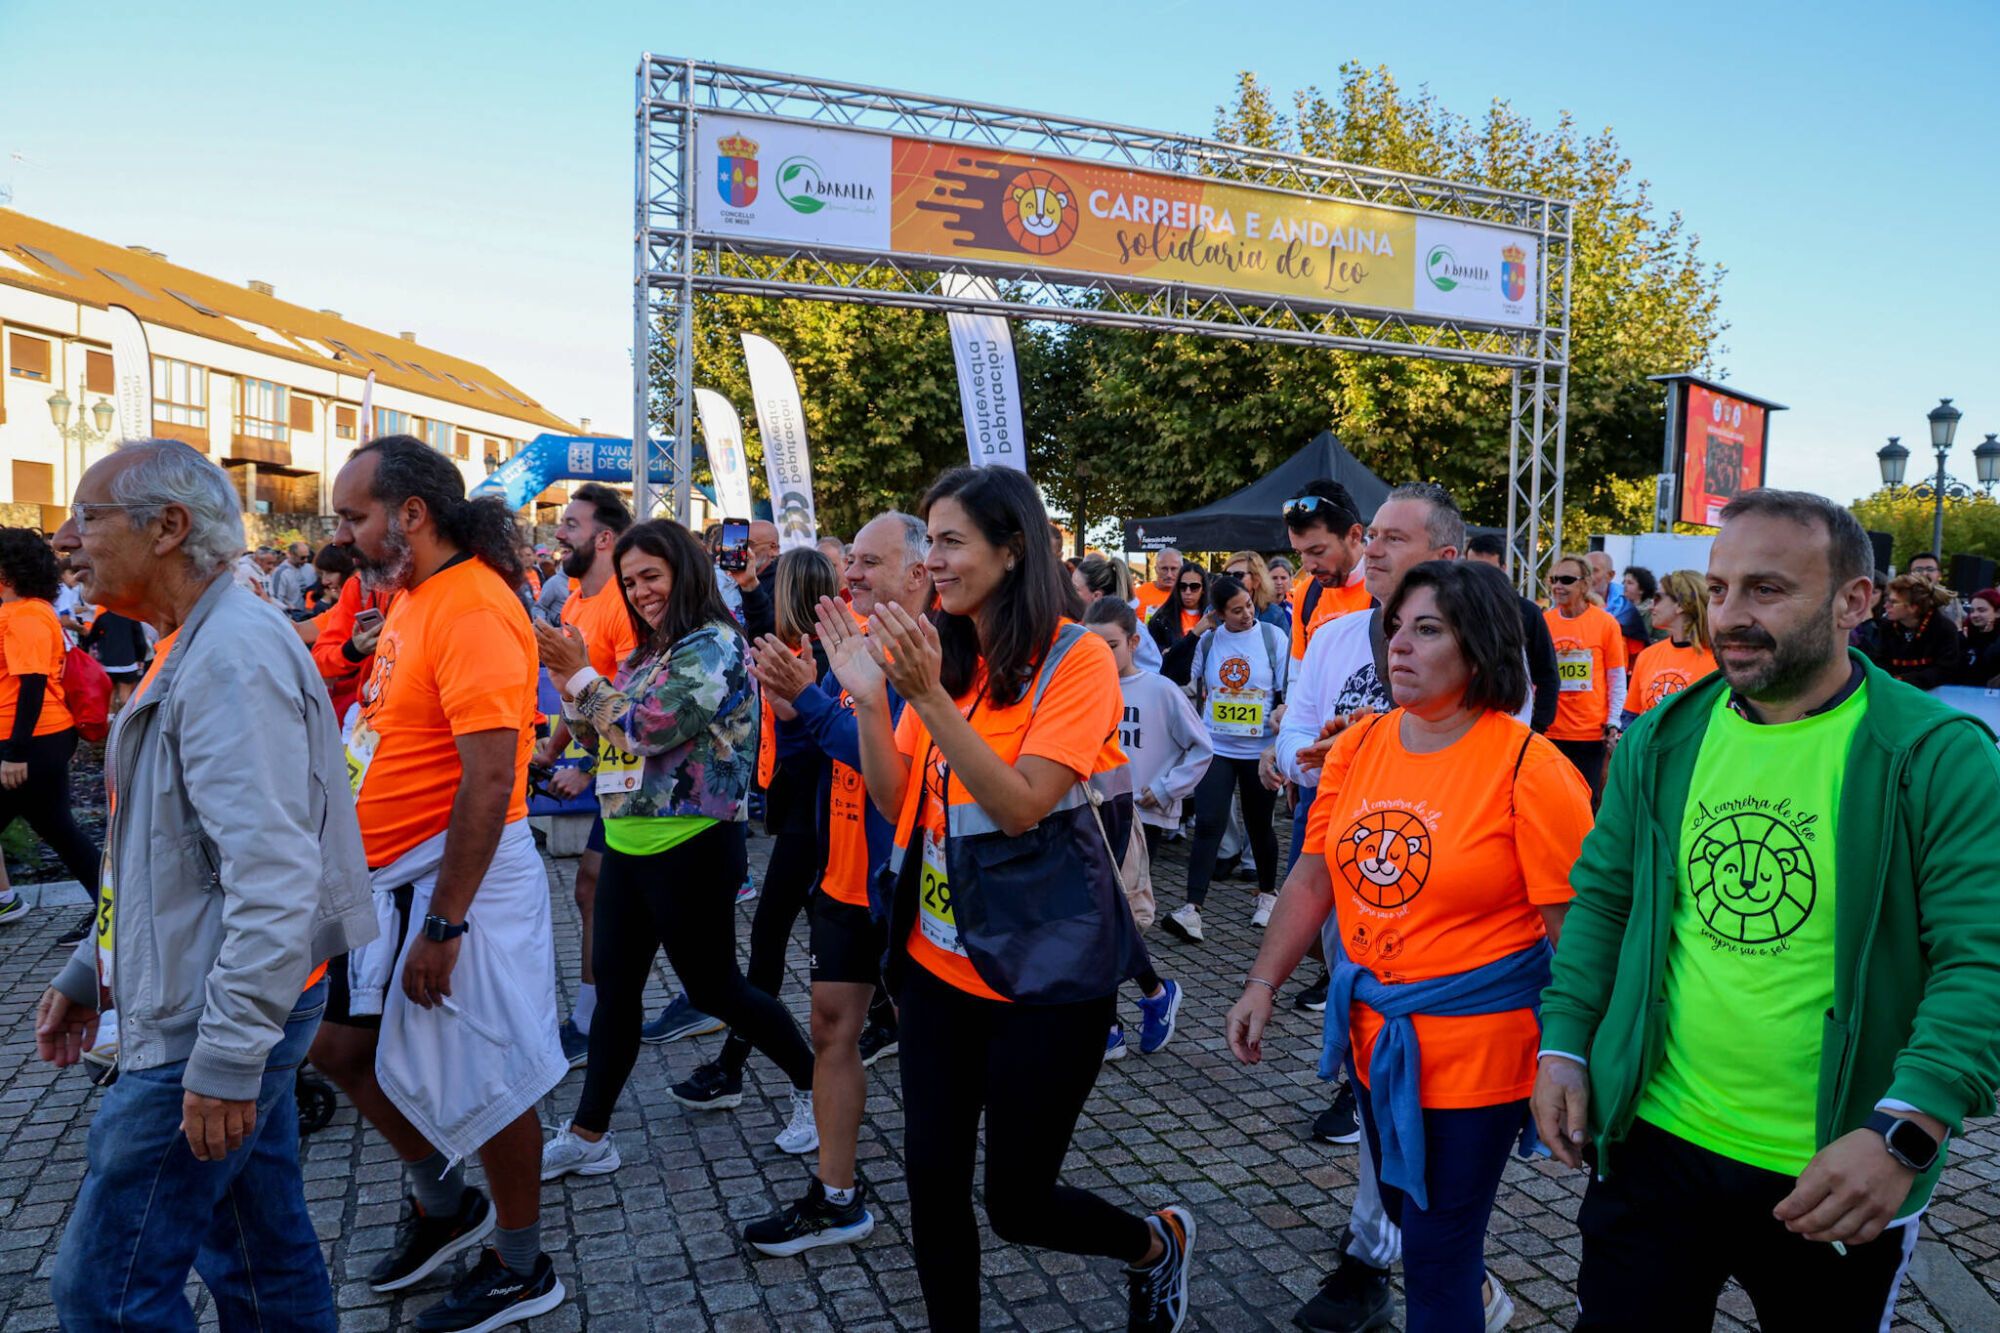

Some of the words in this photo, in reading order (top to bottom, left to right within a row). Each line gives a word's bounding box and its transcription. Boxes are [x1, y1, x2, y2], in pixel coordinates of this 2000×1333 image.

[719, 209, 756, 220] CONCELLO
[724, 217, 734, 225] DE
[1088, 188, 1237, 236] CARREIRA
[1245, 210, 1261, 239] E
[1267, 215, 1395, 257] ANDAINA
[1116, 216, 1268, 273] solidaria
[1276, 237, 1315, 280] de
[1323, 244, 1369, 293] Leo
[598, 444, 635, 457] XUN
[597, 457, 615, 470] DE
[616, 458, 673, 471] GCIA
[1559, 664, 1588, 678] 103
[1122, 705, 1141, 724] n
[1217, 704, 1257, 722] 3121
[1118, 727, 1145, 749] nt
[1690, 800, 1718, 831] A
[1714, 794, 1771, 815] carreira
[1772, 797, 1792, 819] de
[1789, 811, 1819, 842] Leo
[924, 872, 952, 914] 29
[1700, 927, 1738, 953] sempre
[1770, 936, 1791, 957] sol
